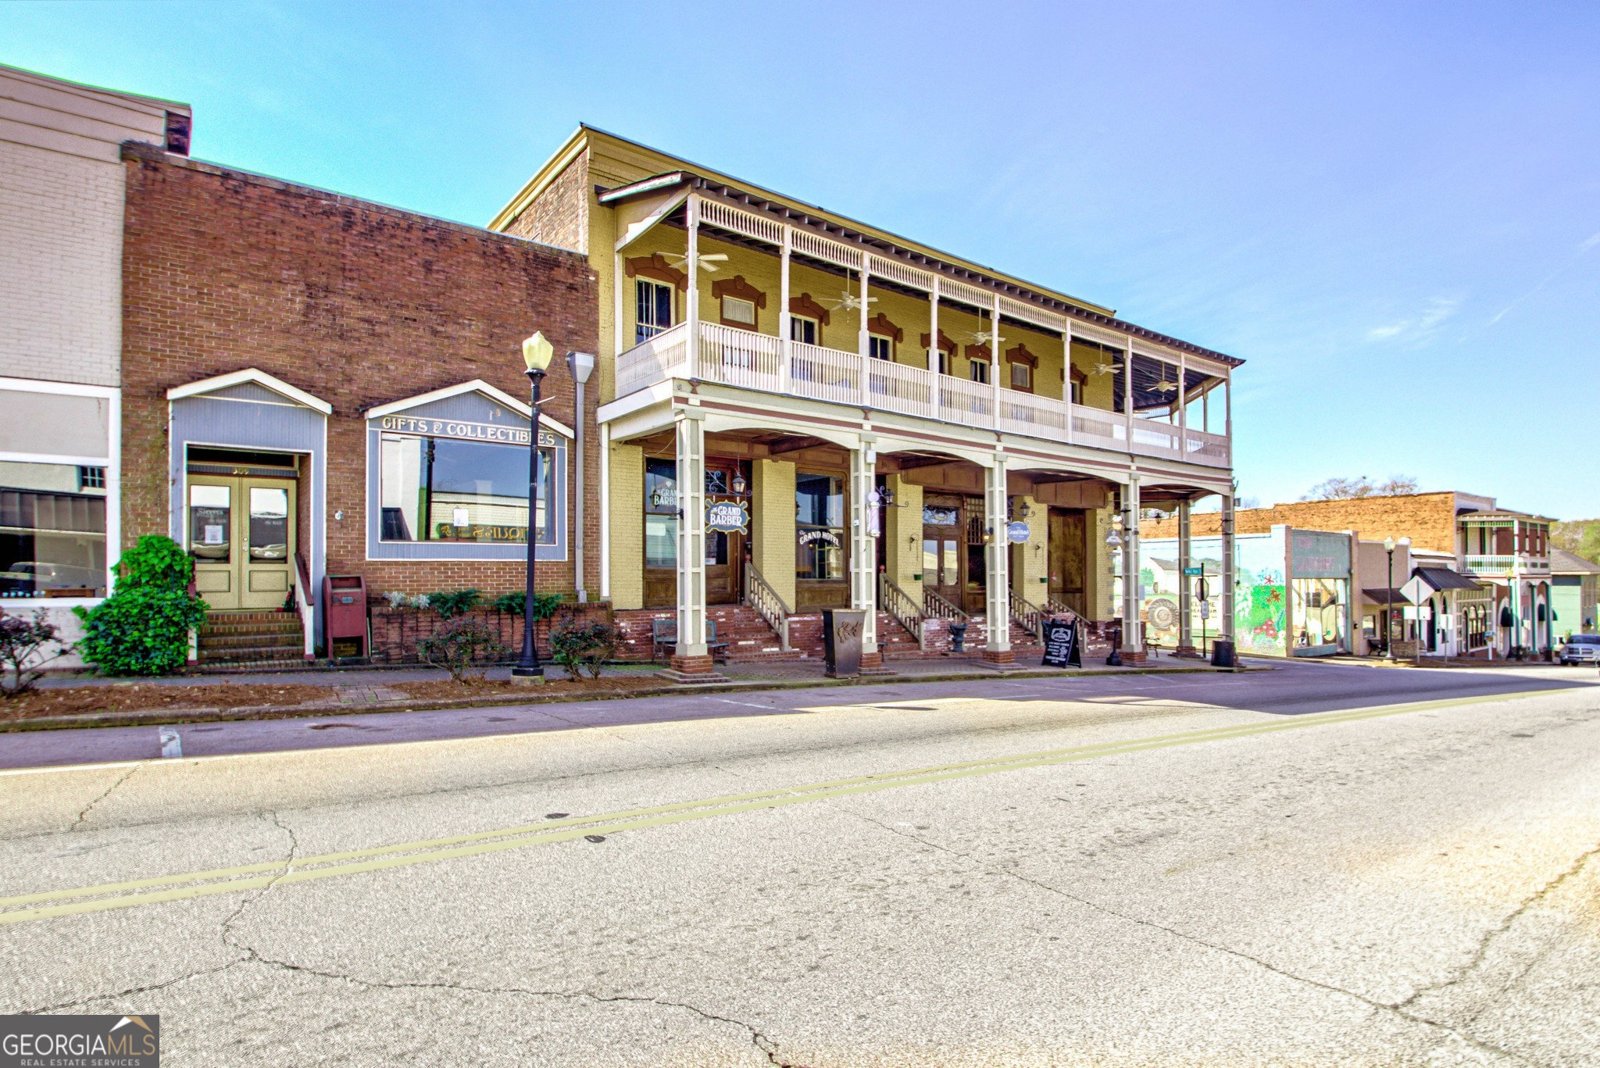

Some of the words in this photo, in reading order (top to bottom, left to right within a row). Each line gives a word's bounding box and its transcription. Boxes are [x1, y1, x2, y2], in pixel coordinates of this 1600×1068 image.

[382, 417, 428, 433] GIFTS
[432, 422, 443, 434] &
[717, 506, 742, 516] GRAND
[710, 514, 743, 527] BARBER
[799, 530, 822, 545] GRAND
